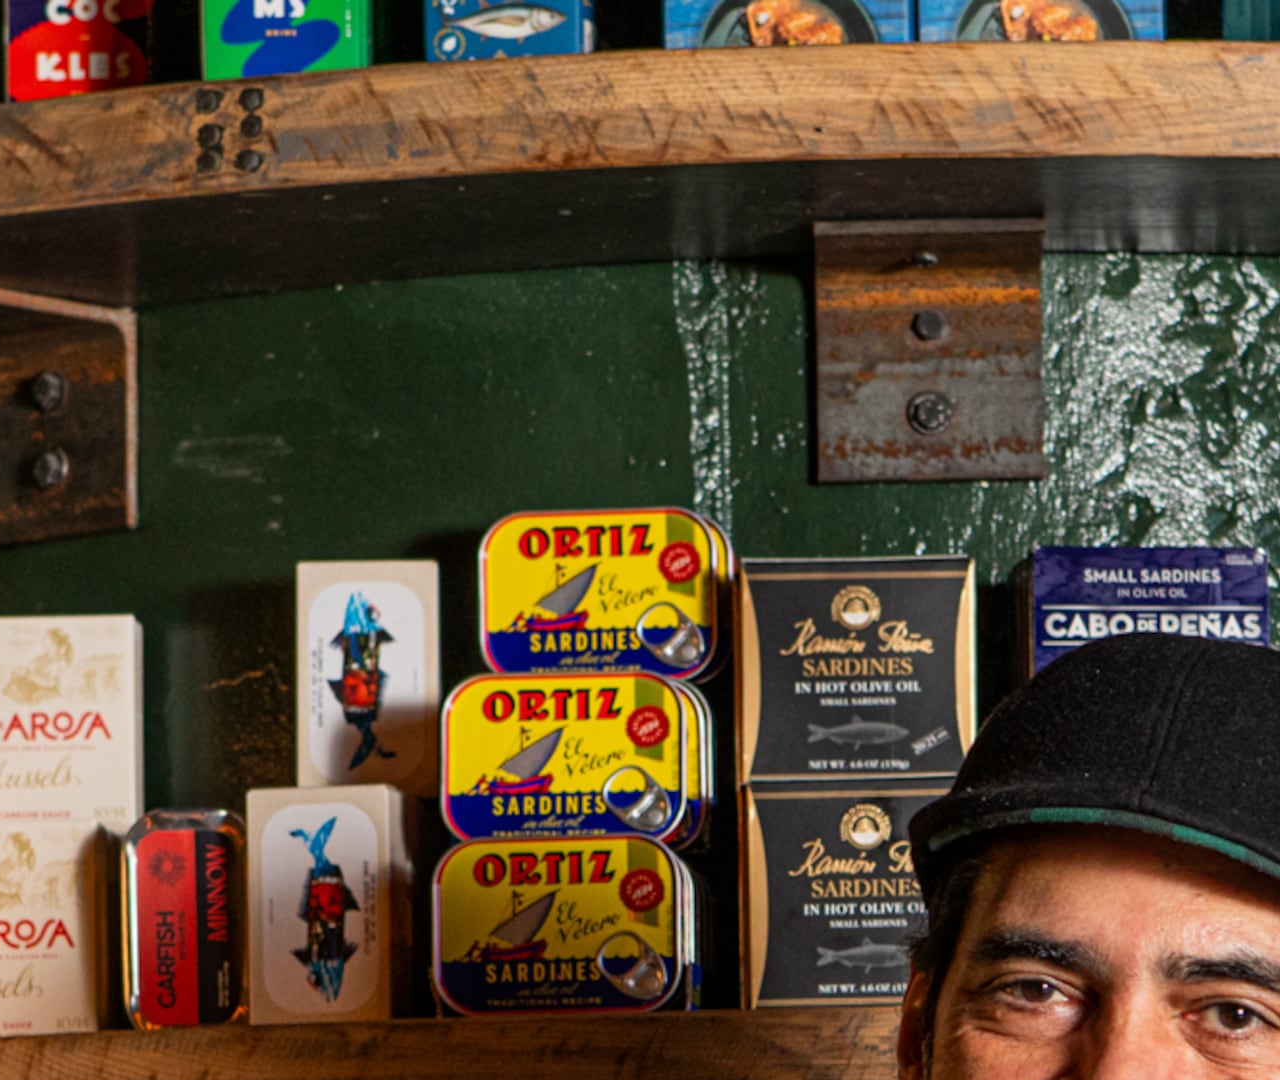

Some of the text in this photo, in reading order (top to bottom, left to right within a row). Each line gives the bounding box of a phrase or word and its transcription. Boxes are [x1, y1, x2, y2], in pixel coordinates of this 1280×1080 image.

[36, 53, 130, 81] KLES
[518, 524, 653, 559] ORTIZ
[1083, 568, 1221, 583] SMALL SARDINES
[1117, 588, 1188, 598] IN OLIVE OIL
[1044, 613, 1134, 638] CABO
[1137, 620, 1157, 632] DE
[530, 631, 642, 653] SARDINES
[802, 657, 913, 678] SARDINES
[795, 680, 921, 694] IN HOT OLIVE OIL
[482, 688, 622, 722] ORTIZ
[851, 697, 896, 706] SARDINES
[3, 711, 111, 741] AROSA
[492, 794, 607, 815] SARDINES
[473, 850, 616, 886] ORTIZ
[206, 844, 228, 941] MINNOW
[811, 878, 921, 898] SARDINES
[804, 904, 820, 916] IN
[824, 903, 858, 915] HOT
[860, 902, 903, 914] OLIVE
[829, 918, 908, 928] SMALL SARDINES
[485, 962, 602, 983] SARDINES
